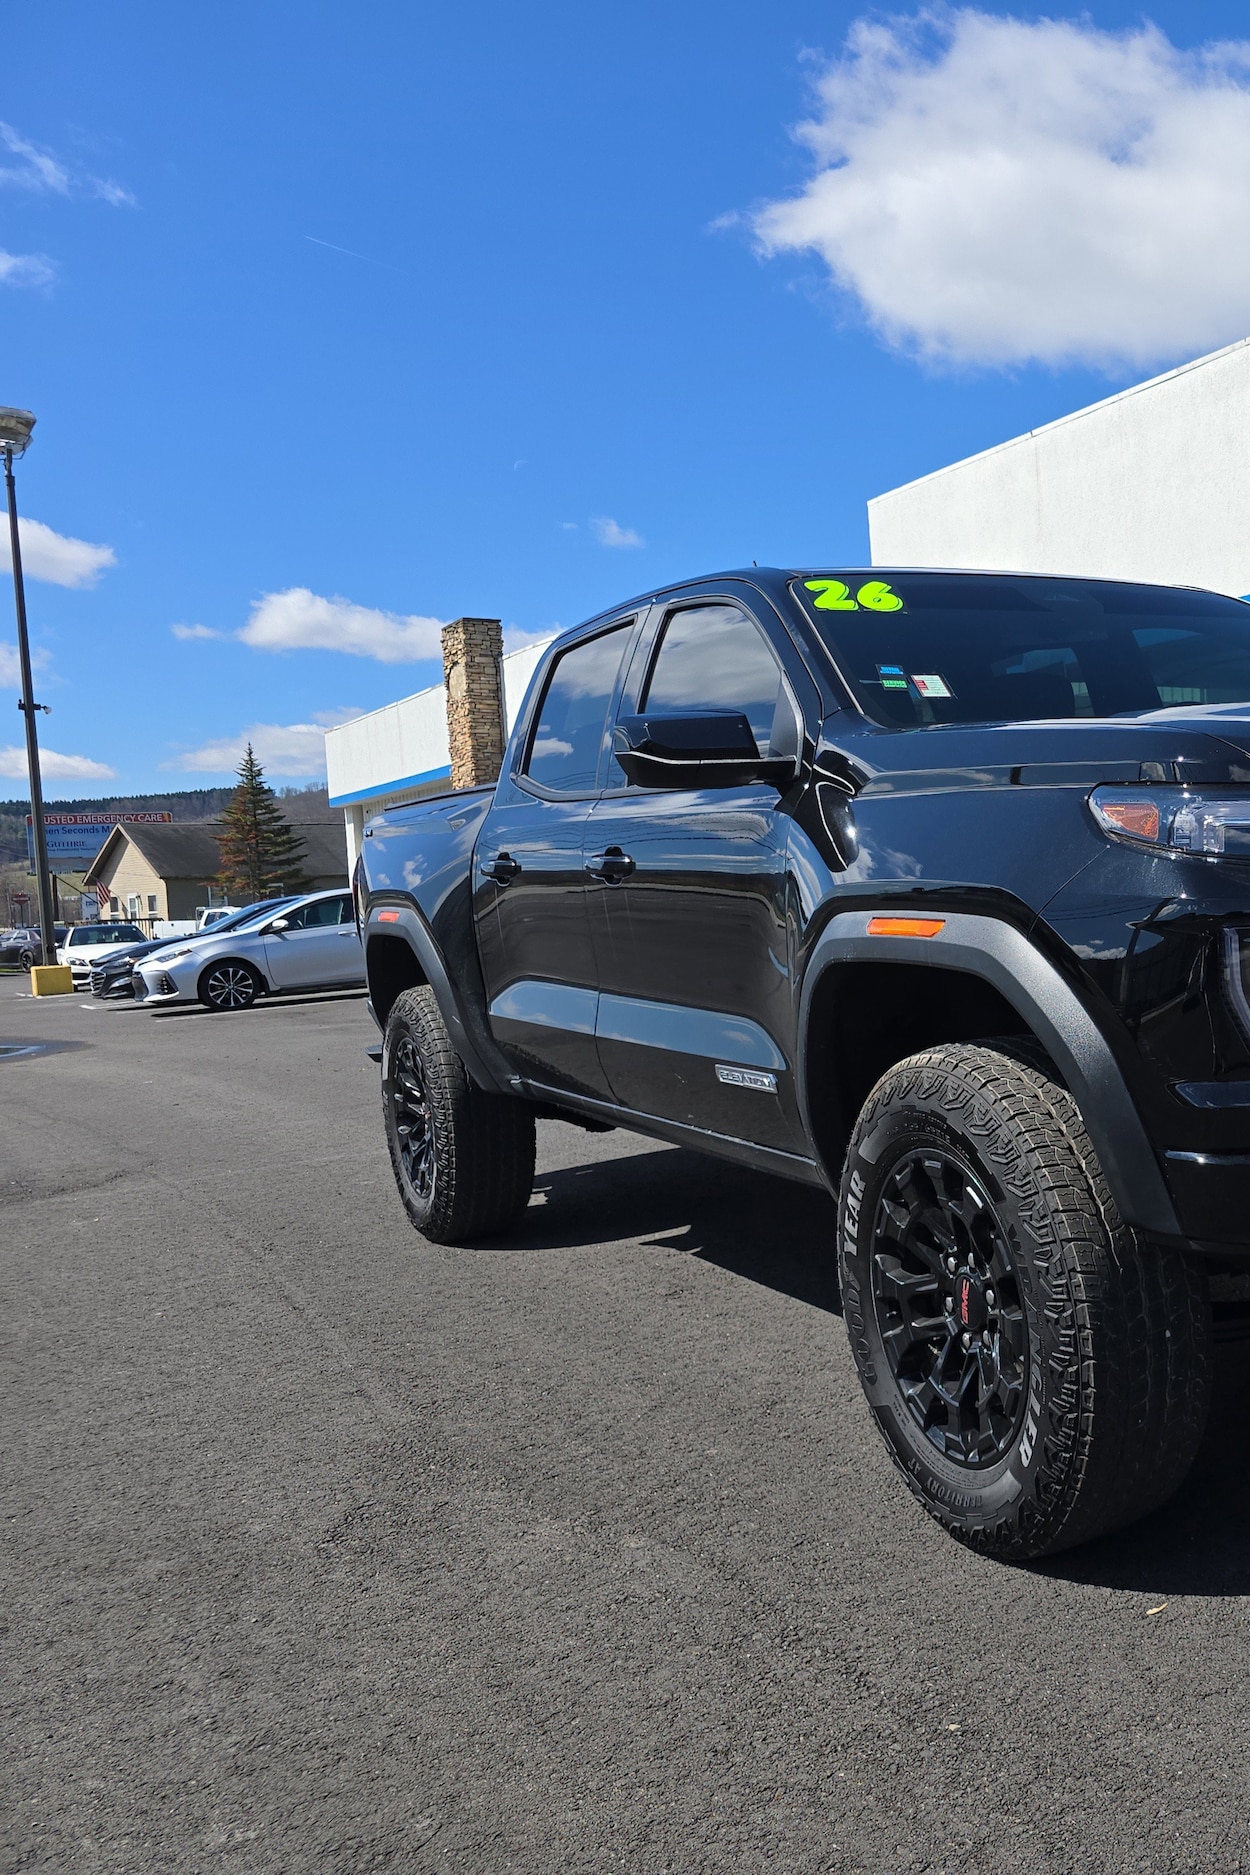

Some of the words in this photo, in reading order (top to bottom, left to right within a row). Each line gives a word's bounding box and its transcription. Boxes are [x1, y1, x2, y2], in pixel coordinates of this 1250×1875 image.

[804, 579, 903, 612] 26
[43, 815, 74, 825] USTED
[77, 813, 136, 824] EMERGENCY
[138, 812, 163, 822] CARE
[45, 827, 59, 835] en
[61, 826, 99, 834] Seconds
[961, 1279, 970, 1324] GMC
[907, 1457, 922, 1475] AT
[923, 1476, 984, 1508] TERRITORY
